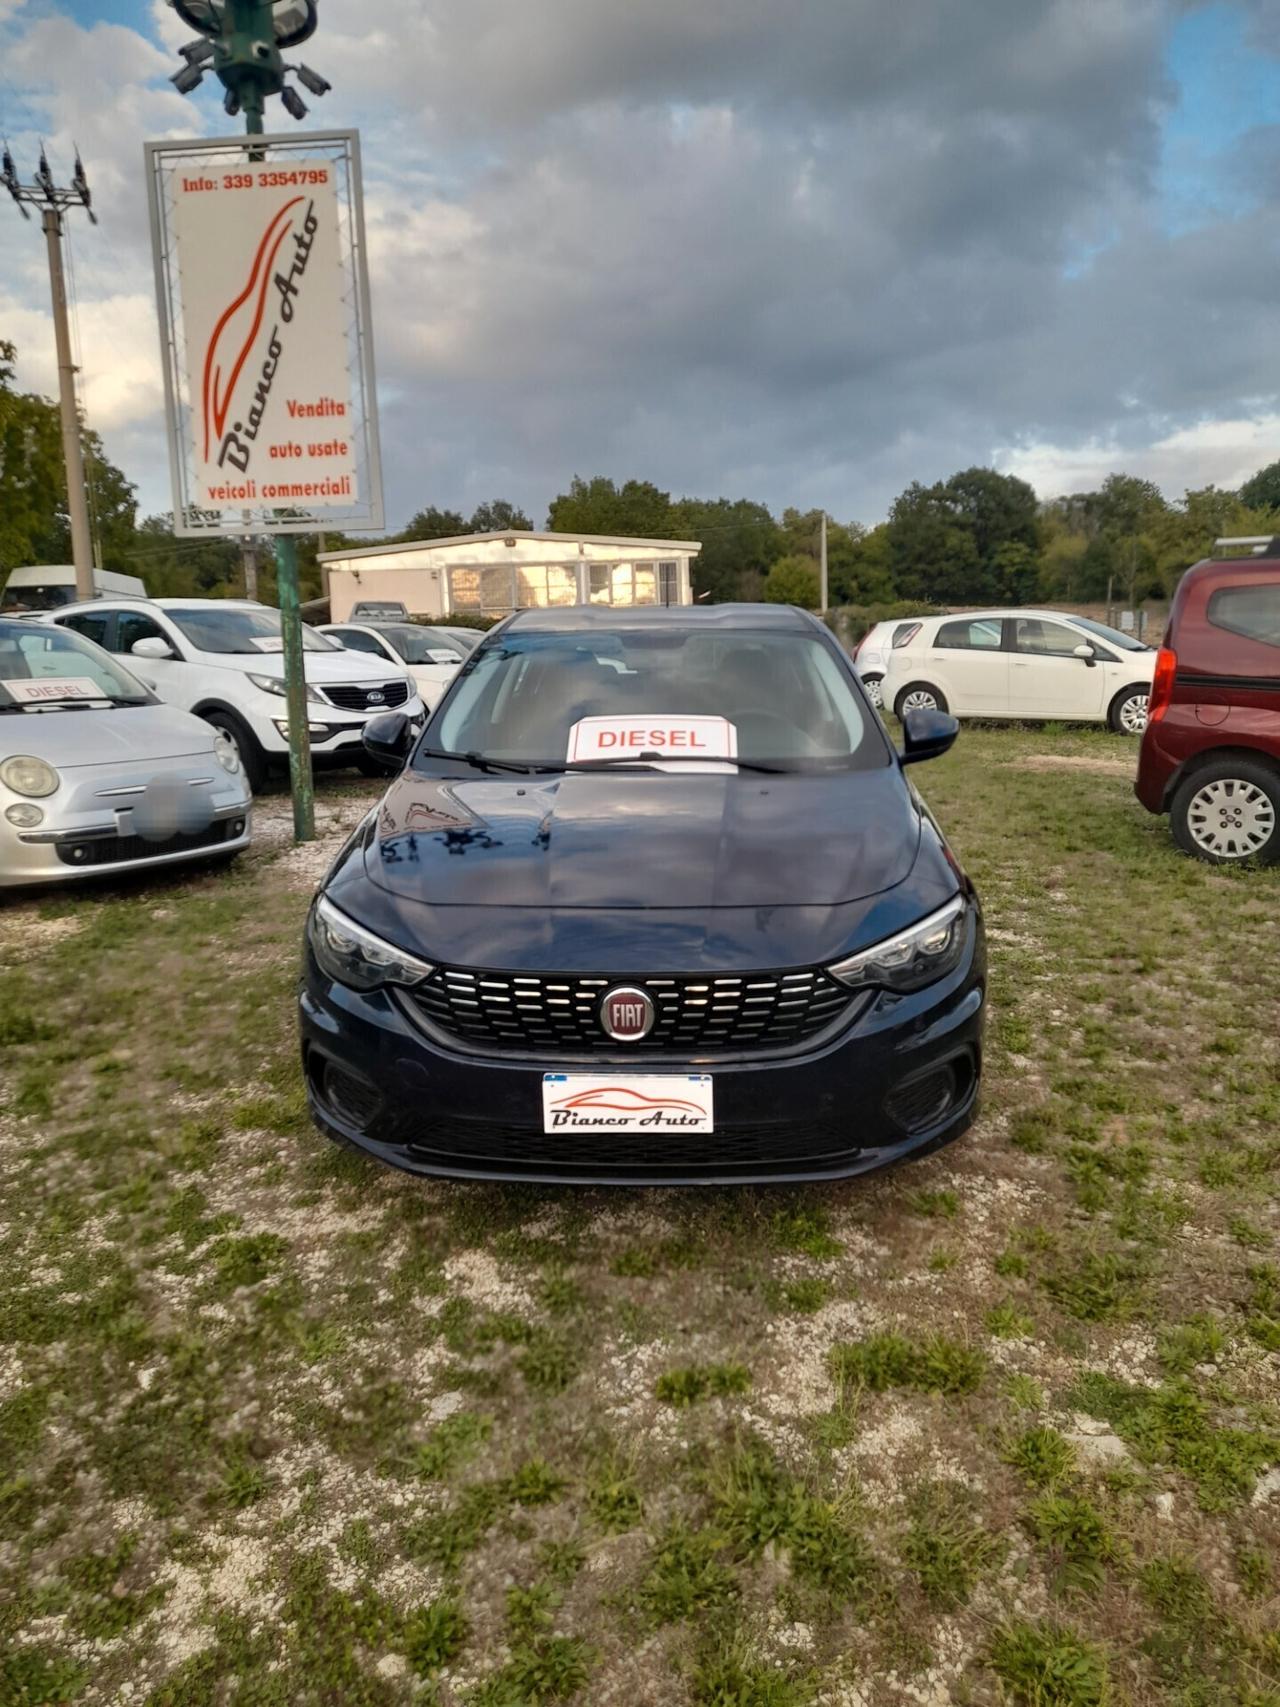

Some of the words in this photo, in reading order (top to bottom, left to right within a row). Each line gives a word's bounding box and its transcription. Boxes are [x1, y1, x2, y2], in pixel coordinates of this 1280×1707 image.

[182, 177, 218, 192] Info:
[223, 174, 253, 189] 339
[258, 170, 328, 187] 3354795
[217, 325, 283, 473] Bianco
[273, 199, 318, 323] Auto
[287, 397, 345, 418] Vendita
[269, 440, 302, 458] auto
[307, 439, 348, 457] usate
[208, 479, 256, 499] veicoli
[261, 475, 350, 498] commerciali
[25, 685, 89, 698] DIESEL
[597, 730, 706, 748] DIESEL
[612, 1003, 643, 1028] FIAT
[550, 1109, 636, 1126] Bianco
[639, 1110, 707, 1126] Auto
